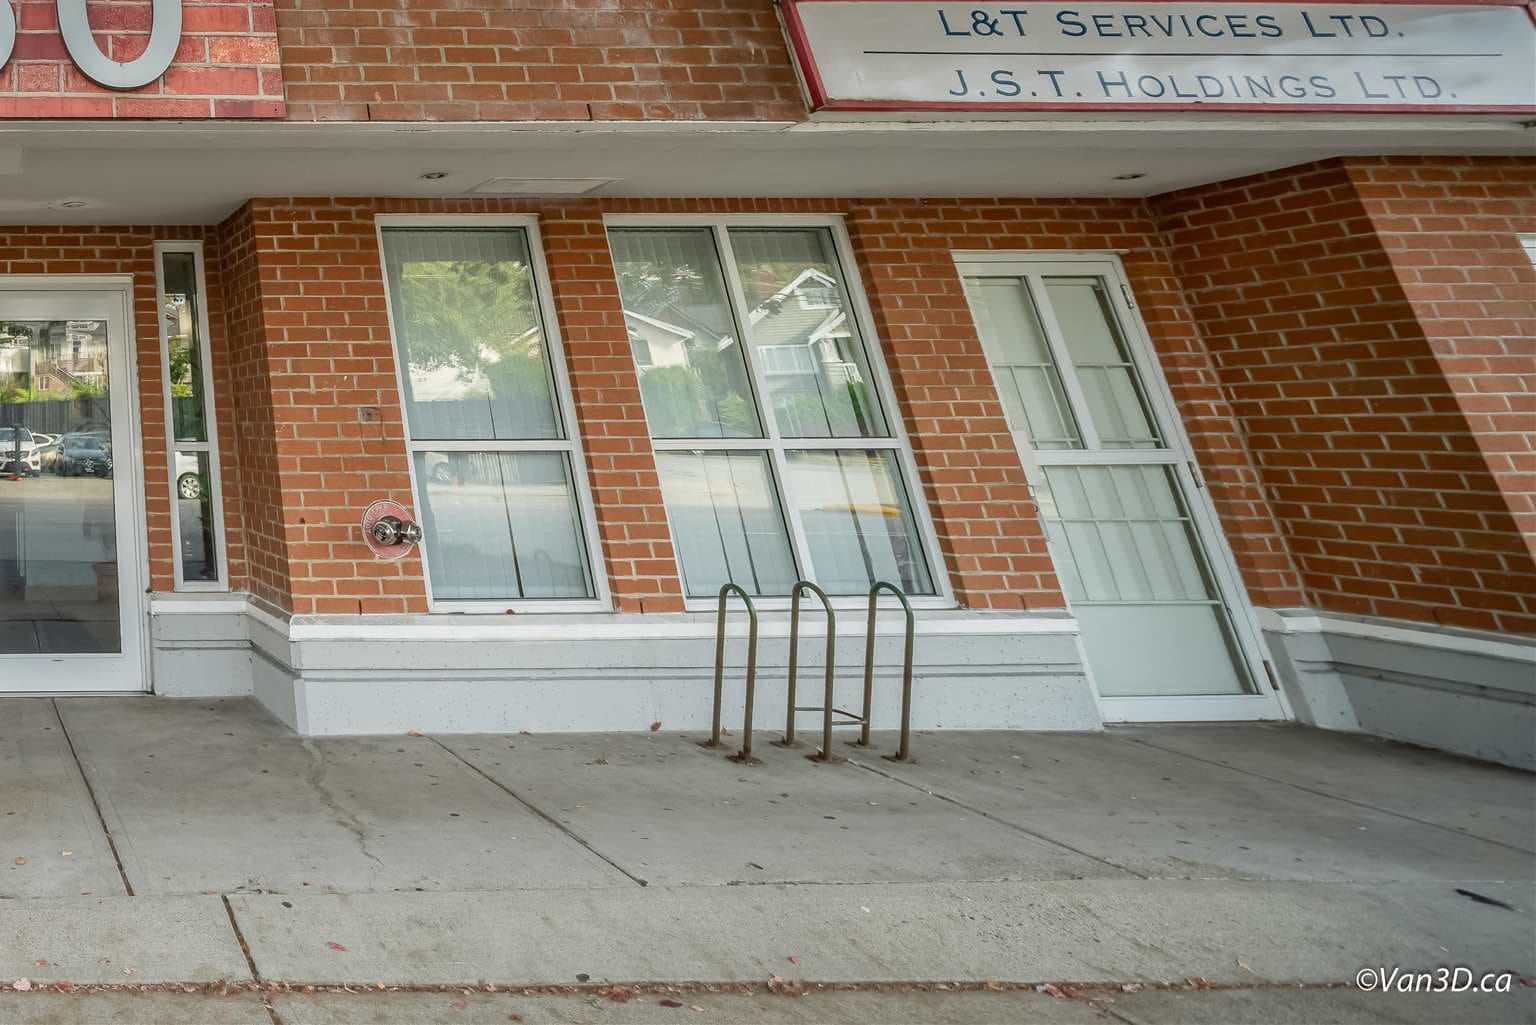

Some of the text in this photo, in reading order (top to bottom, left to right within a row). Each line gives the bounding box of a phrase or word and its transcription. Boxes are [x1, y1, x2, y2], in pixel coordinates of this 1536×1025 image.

[936, 9, 1404, 39] L&T SERVICES LTD.
[948, 69, 1457, 100] J.S.T. HOLDINGS LTD.
